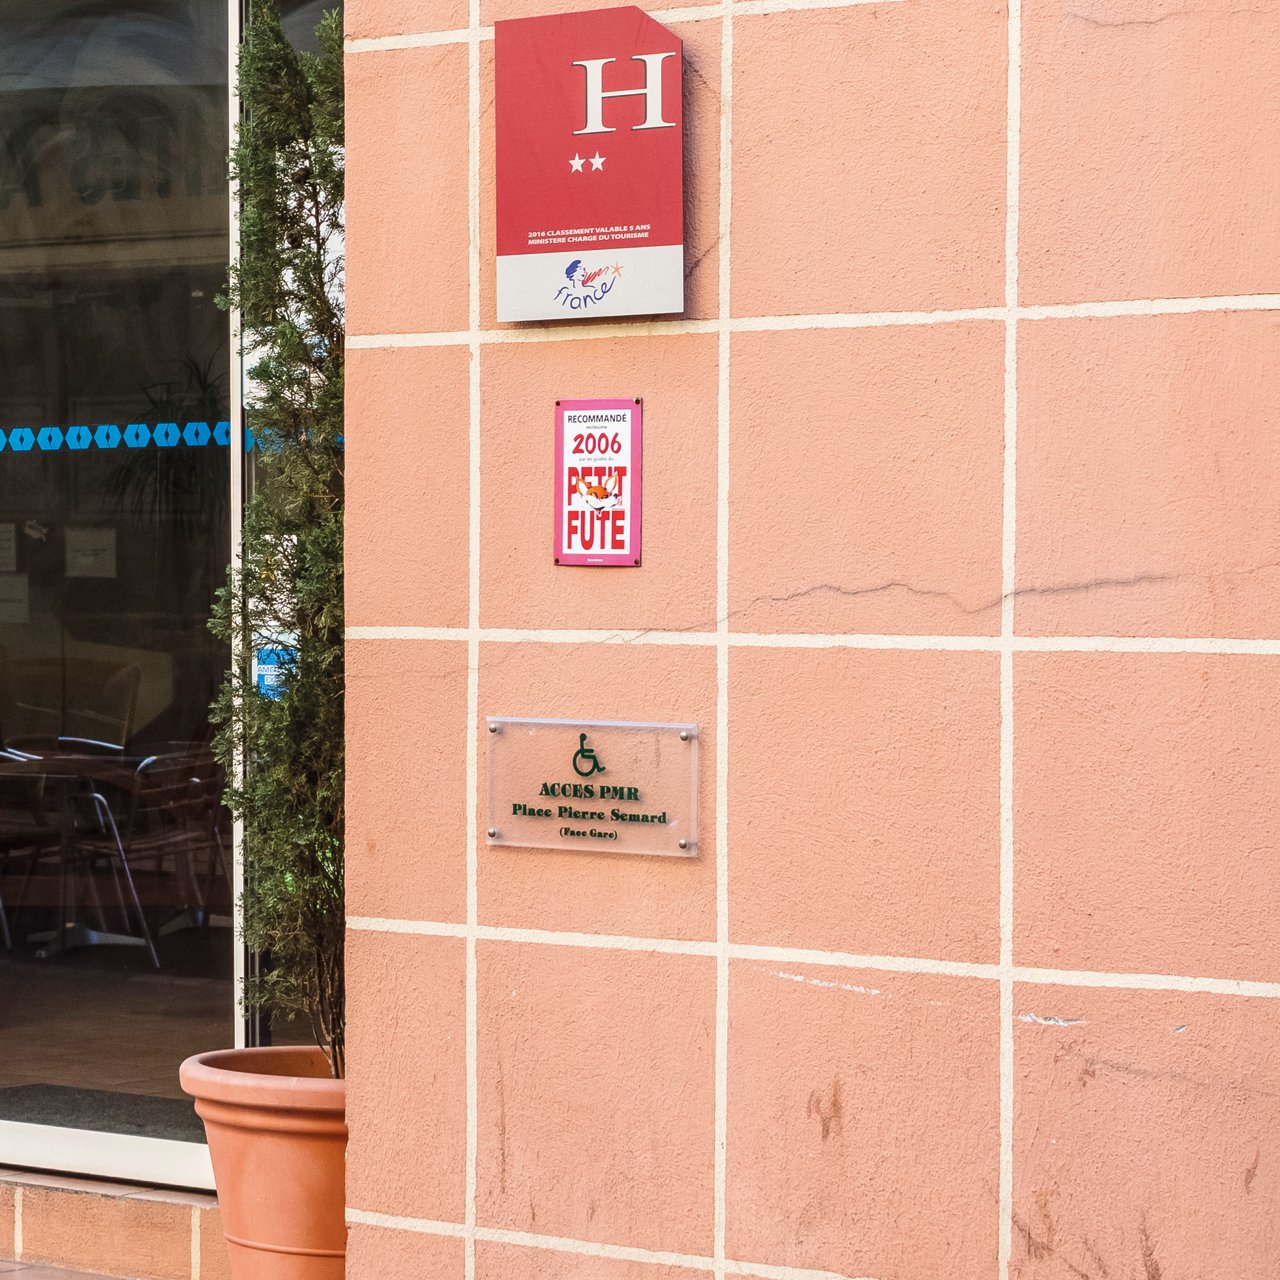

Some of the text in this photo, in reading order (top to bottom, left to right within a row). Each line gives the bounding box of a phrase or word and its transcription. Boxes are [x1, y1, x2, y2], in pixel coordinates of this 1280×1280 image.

[572, 52, 676, 135] H
[528, 237, 567, 245] MINISTERE
[567, 235, 597, 243] CHARGE
[611, 232, 649, 240] TOURISME
[547, 228, 594, 237] CLASSEMENT
[568, 412, 627, 423] RECOMMANDÉ
[572, 432, 622, 454] 2006
[568, 466, 627, 506] PETT
[539, 782, 640, 801] ACCES PMR
[512, 803, 667, 824] Place Pierre Semard
[560, 827, 618, 840] (Face Gare)
